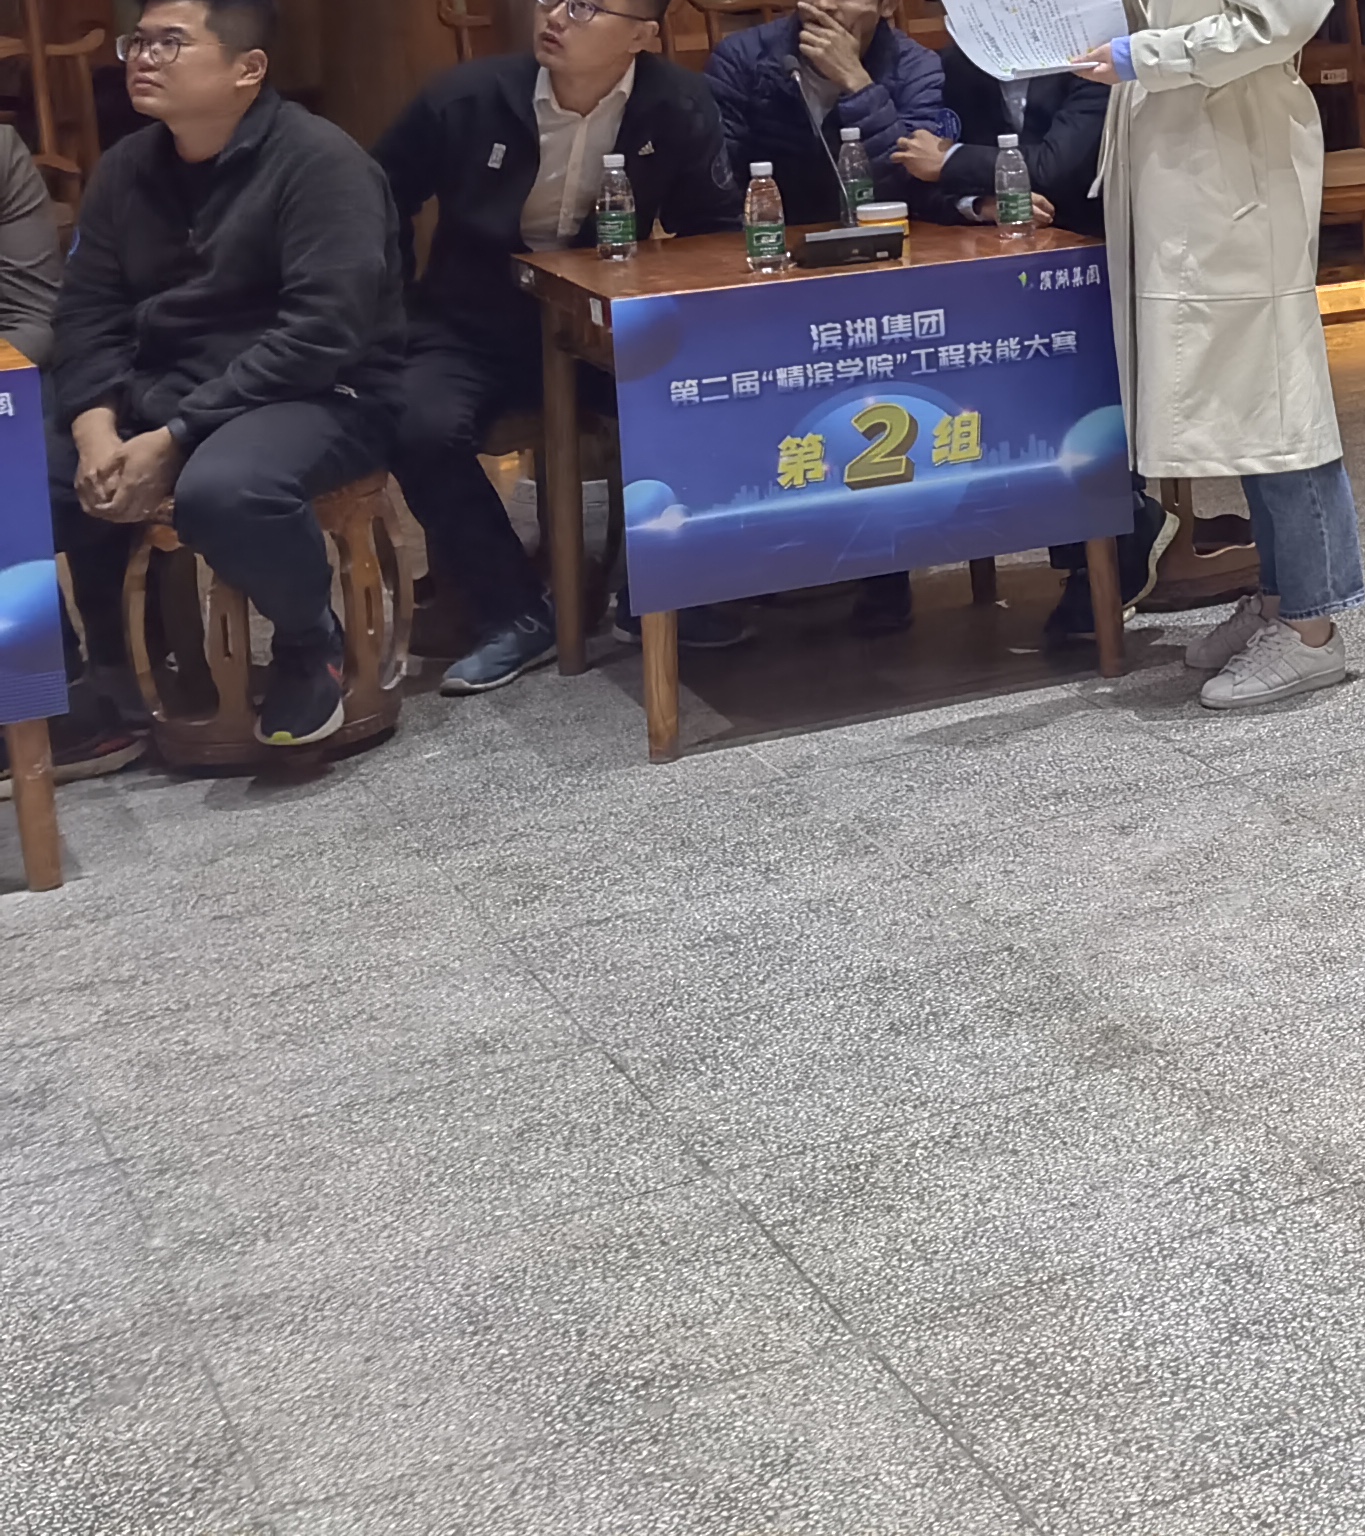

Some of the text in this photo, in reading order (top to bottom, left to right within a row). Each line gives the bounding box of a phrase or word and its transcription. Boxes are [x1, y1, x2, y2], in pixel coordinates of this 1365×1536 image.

[810, 309, 946, 352] 滨湖集团
[776, 402, 983, 491] 第2组
